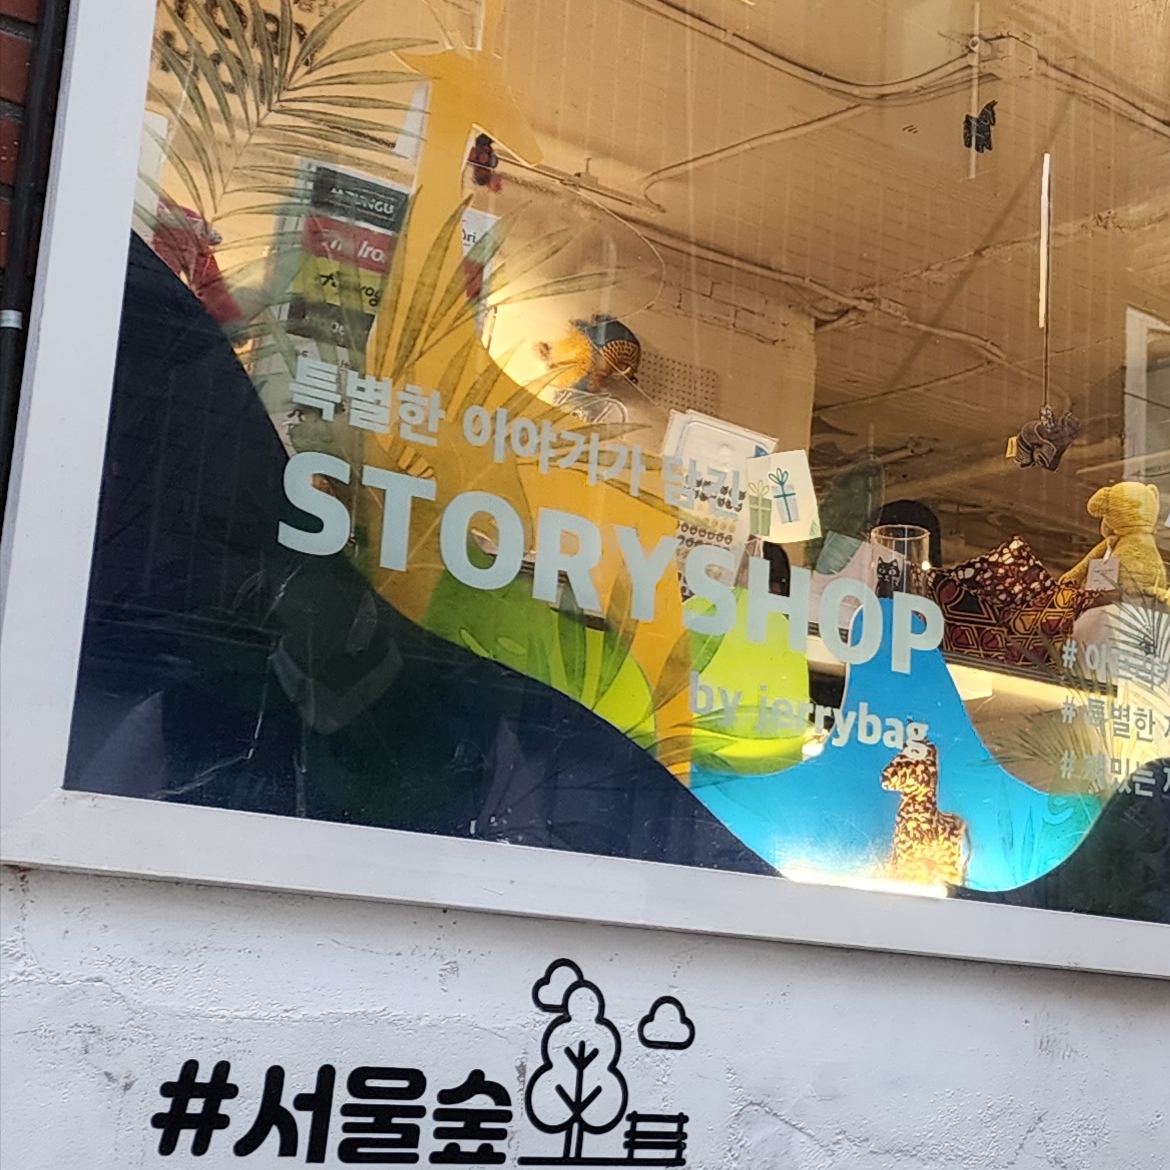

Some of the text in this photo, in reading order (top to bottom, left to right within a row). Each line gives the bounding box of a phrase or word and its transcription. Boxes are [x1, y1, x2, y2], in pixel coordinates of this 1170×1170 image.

[289, 355, 446, 447] 특별한
[462, 405, 650, 498] 이야기가
[278, 451, 945, 676] STORYSHOP
[690, 670, 930, 760] by jerrybag
[150, 1058, 513, 1165] #서울숲
